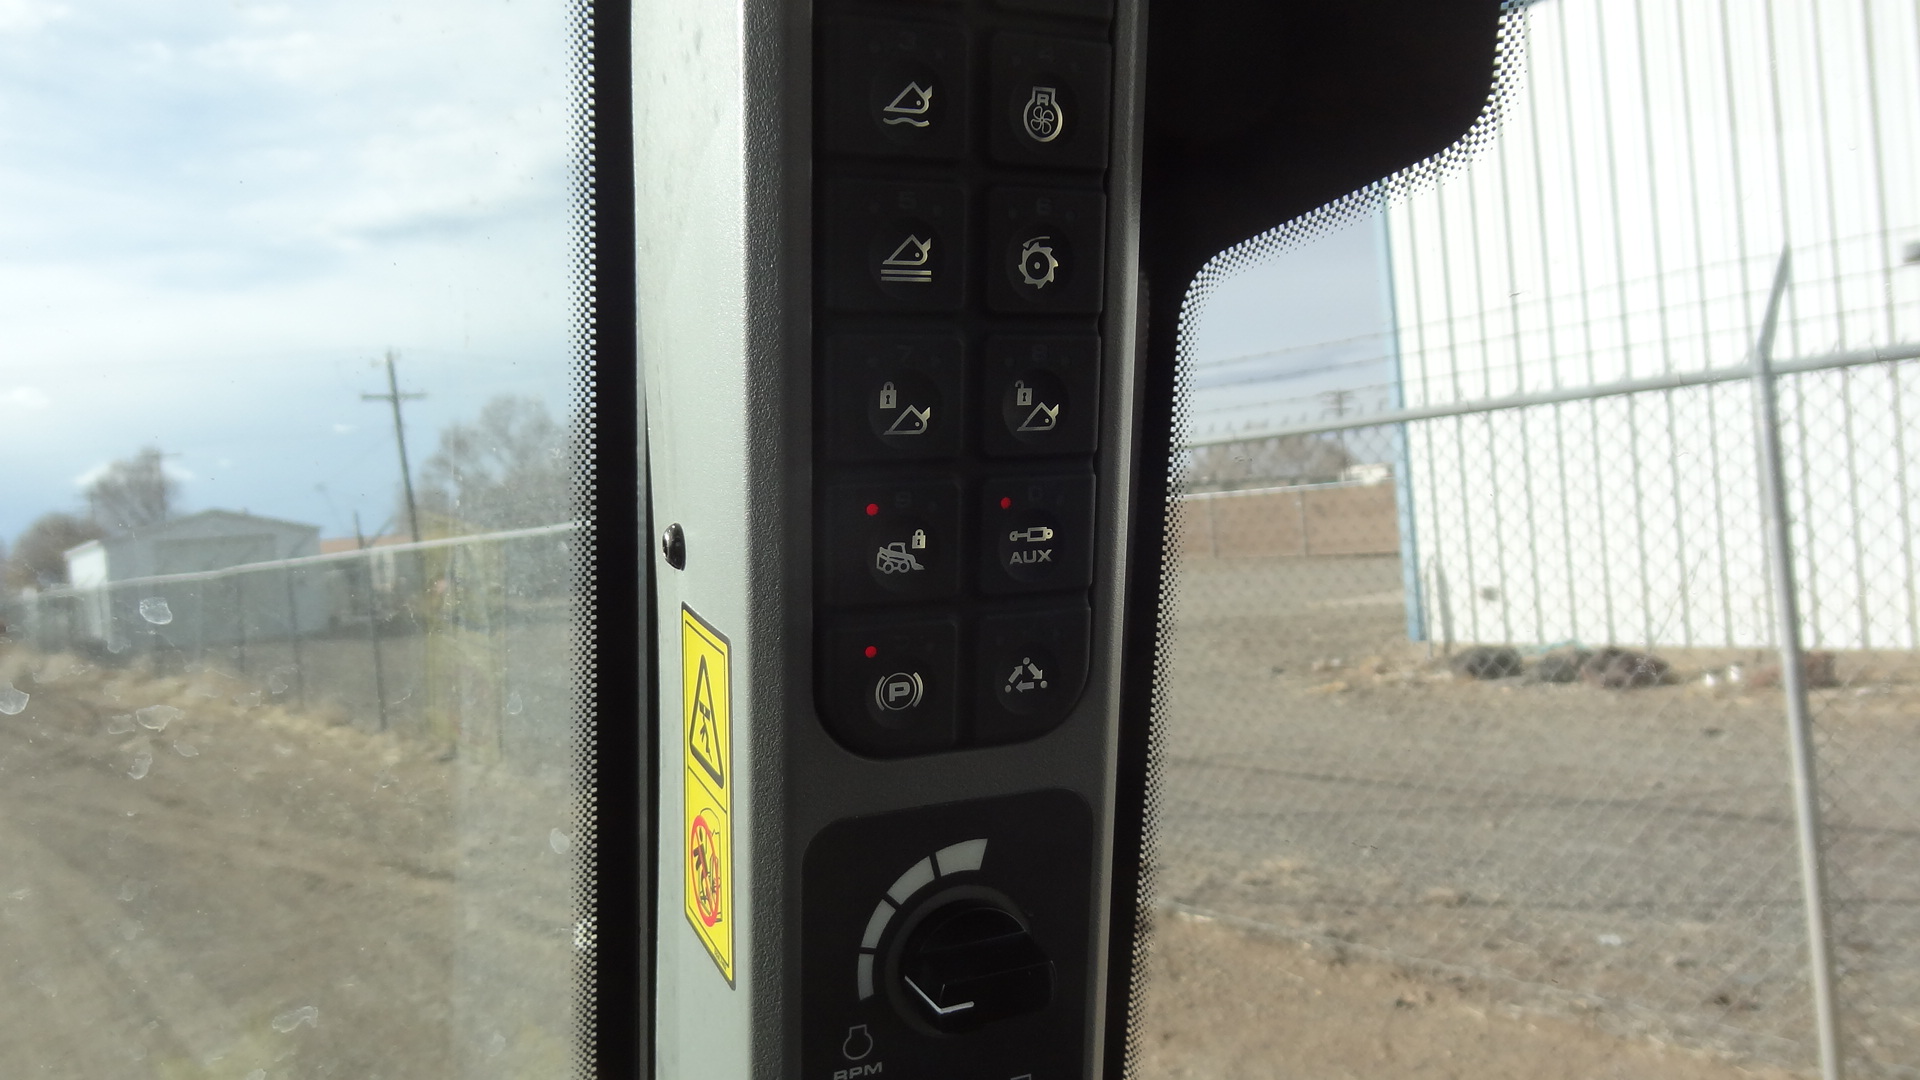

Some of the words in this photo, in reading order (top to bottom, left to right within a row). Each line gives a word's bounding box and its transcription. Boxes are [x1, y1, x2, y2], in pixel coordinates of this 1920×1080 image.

[1009, 549, 1053, 565] AUX
[889, 682, 911, 702] P
[832, 1060, 883, 1080] RPM
